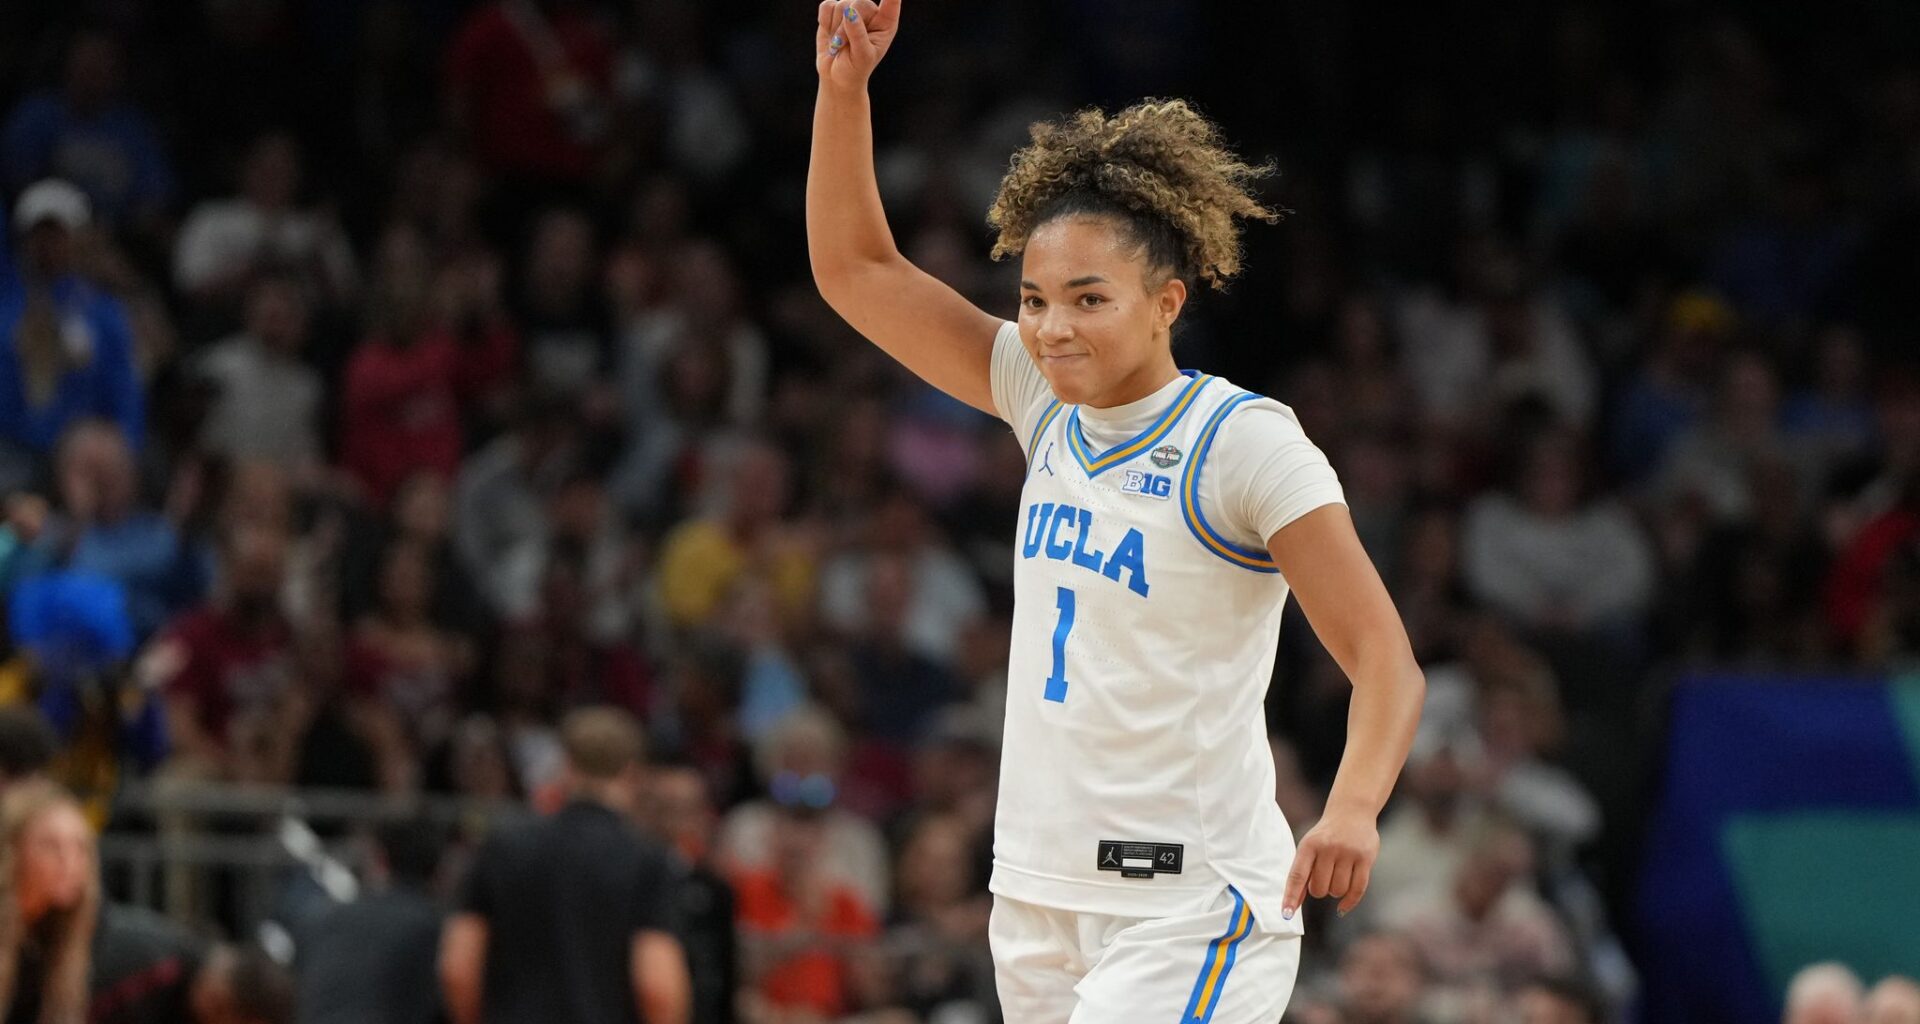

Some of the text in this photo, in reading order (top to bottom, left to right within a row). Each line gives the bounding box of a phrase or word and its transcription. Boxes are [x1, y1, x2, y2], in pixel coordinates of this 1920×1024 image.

[1023, 503, 1149, 598] UCLA
[1043, 586, 1075, 703] 1
[1159, 852, 1175, 865] 42
